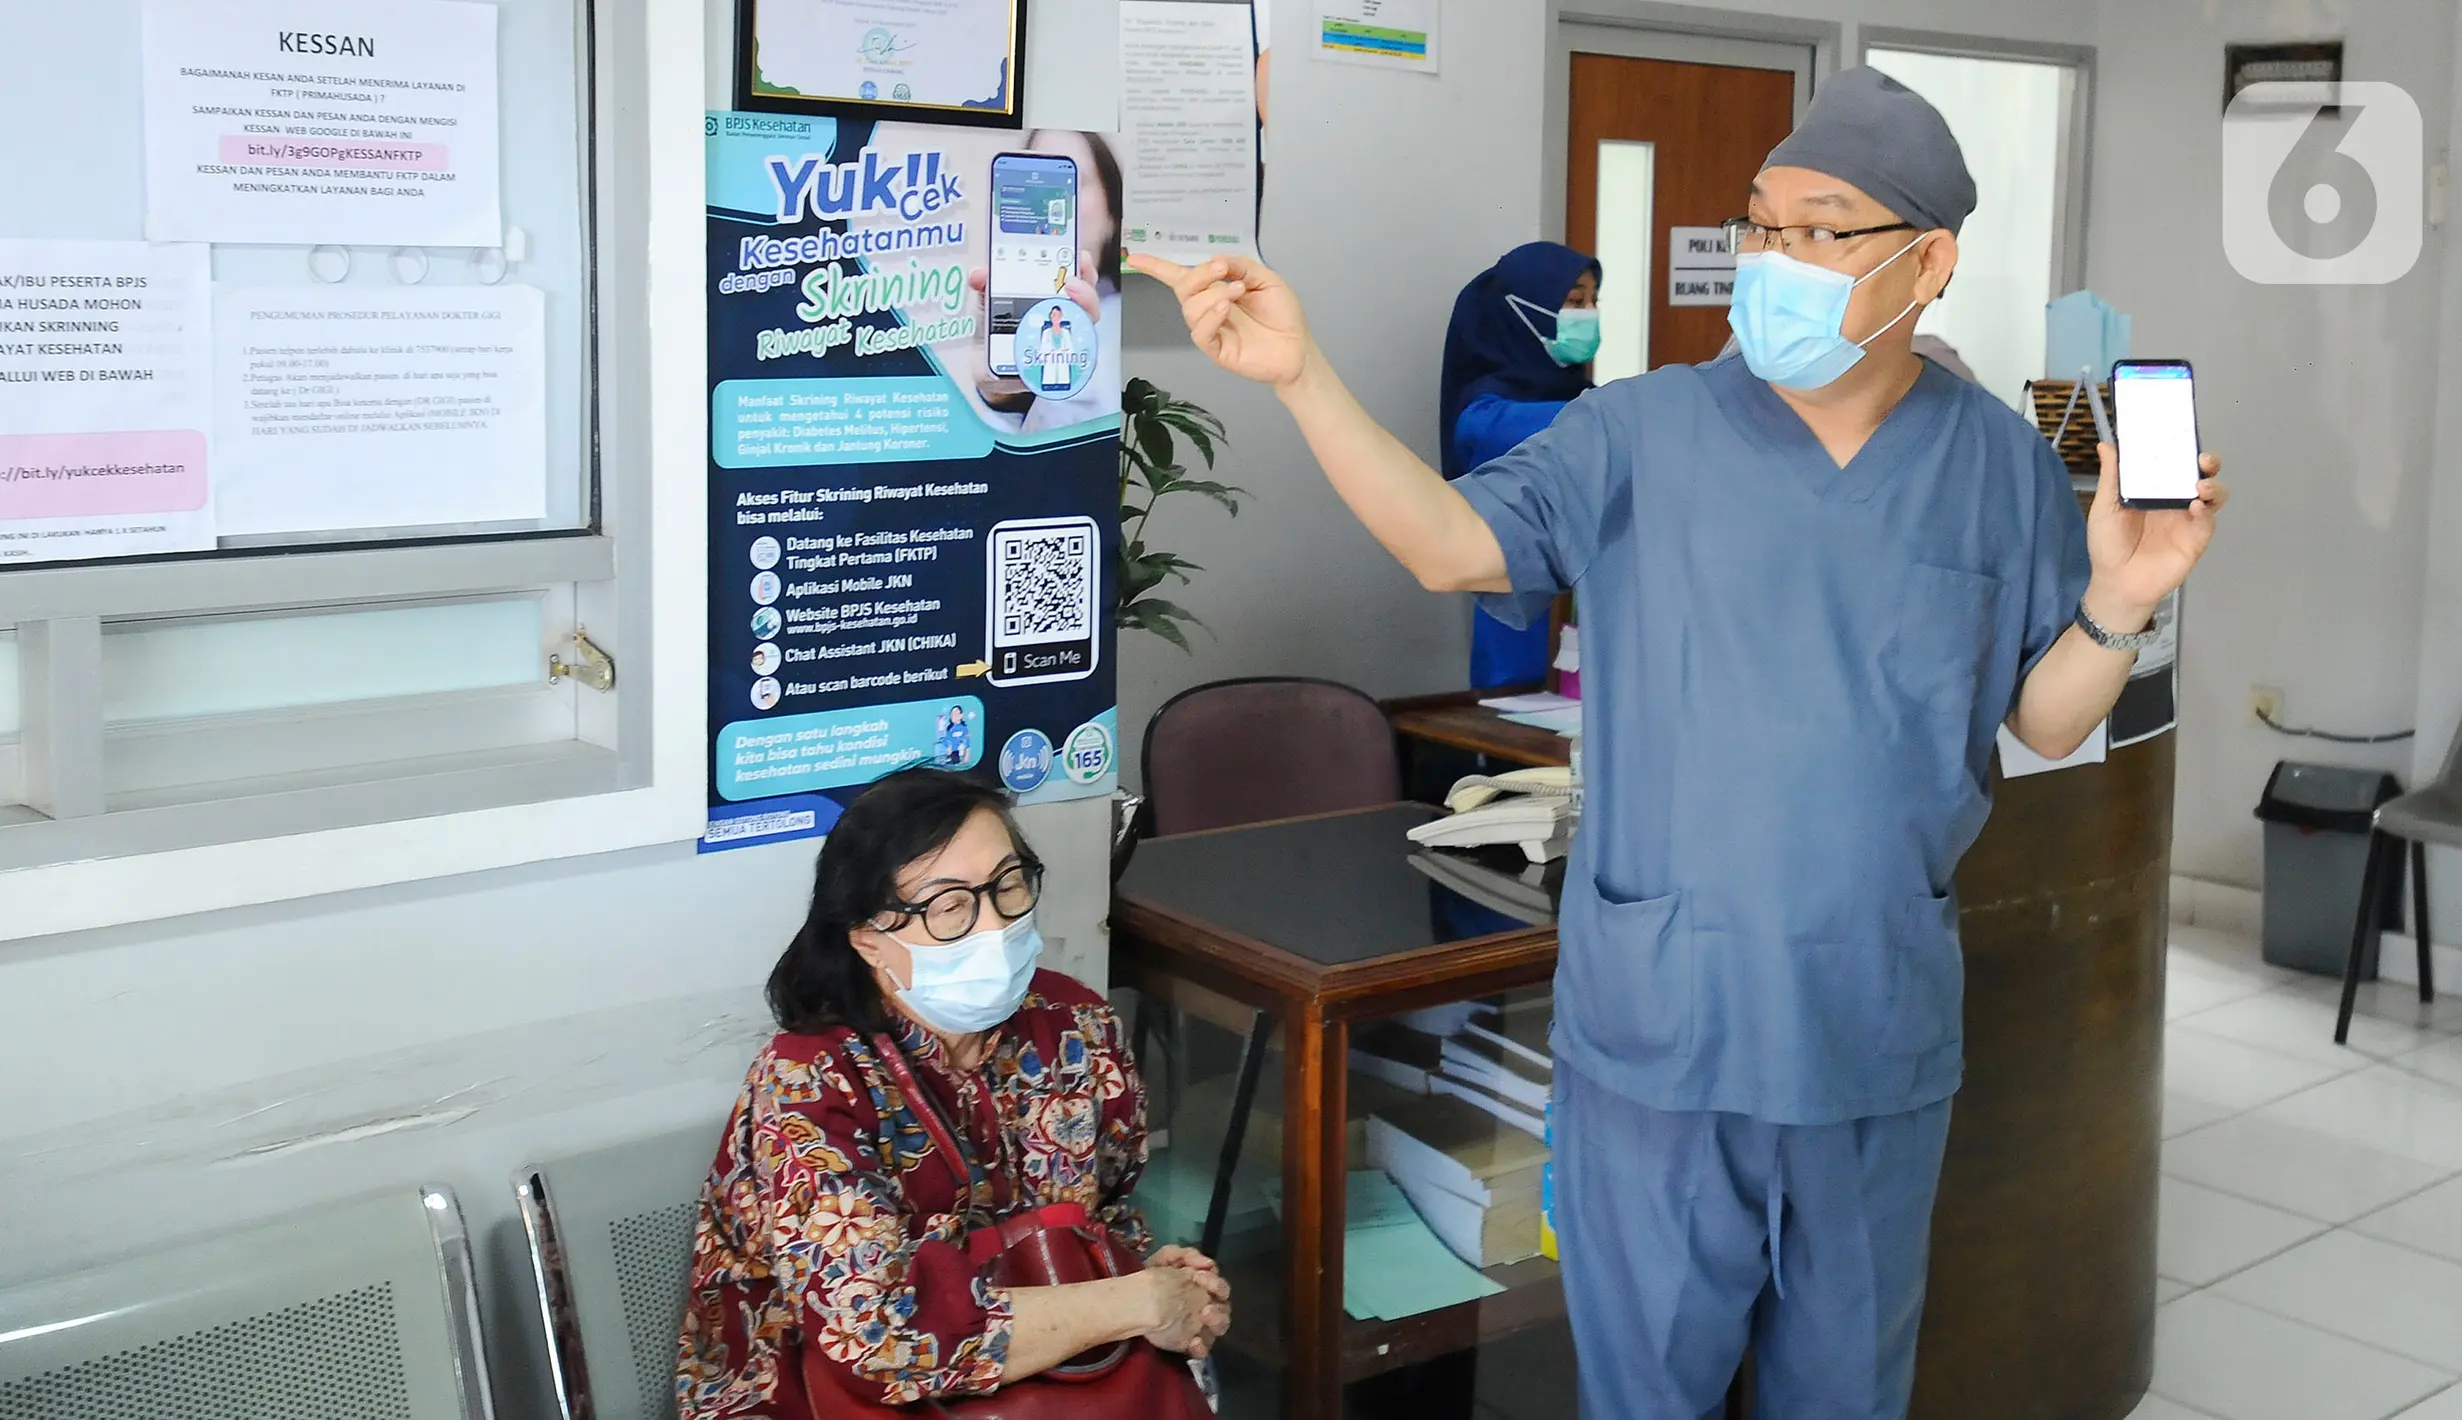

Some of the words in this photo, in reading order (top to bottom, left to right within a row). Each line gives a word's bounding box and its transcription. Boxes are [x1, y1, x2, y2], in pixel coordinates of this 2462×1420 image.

[280, 31, 374, 57] KESSAN
[180, 67, 251, 80] BAGAIMANAH
[253, 72, 284, 82] KESAN
[287, 74, 314, 84] ANDA
[317, 75, 356, 86] SETELAH
[359, 77, 410, 88] MENERIMA
[412, 80, 454, 92] LAYANAN
[456, 84, 466, 92] DI
[271, 88, 294, 98] FKTP
[302, 90, 372, 102] PRIMAHUSADA
[192, 105, 251, 117] SAMPAIKAN
[254, 108, 291, 118] KESSAN
[293, 110, 314, 120] DAN
[317, 112, 346, 121] PESAN
[349, 112, 376, 122] ANDA
[378, 114, 416, 124] DENGAN
[419, 116, 458, 126] MENGISI
[725, 117, 750, 130] BPJS
[752, 119, 811, 132] Kesehatan
[244, 124, 280, 134] KESSAN
[285, 126, 307, 135] WEB
[309, 127, 348, 136] GOOGLE
[350, 128, 360, 137] DI
[362, 130, 398, 139] BAWAH
[400, 131, 412, 140] INI
[196, 164, 237, 175] KESSAN
[240, 166, 263, 176] DAN
[266, 166, 298, 177] PESAN
[300, 168, 331, 178] ANDA
[334, 169, 394, 180] MEMBANTU
[396, 172, 419, 181] FKTP
[421, 172, 456, 182] DALAM
[233, 182, 318, 194] MENINGKATKAN
[320, 186, 368, 196] LAYANAN
[370, 187, 394, 196] BAGI
[396, 188, 425, 198] ANDA
[743, 222, 964, 268] Kesehatanmu
[1688, 240, 1713, 252] POLI
[51, 276, 112, 288] PESERTA
[116, 276, 148, 288] BPJS
[720, 270, 794, 293] dengan
[800, 260, 963, 318] Skrining
[1675, 282, 1710, 296] RUANG
[0, 298, 13, 310] A
[18, 298, 80, 310] HUSADA
[84, 298, 142, 310] MOHON
[250, 310, 325, 321] PENGUMUMAN
[327, 310, 379, 320] PROSEDUR
[380, 310, 439, 320] PELAYANAN
[441, 310, 478, 320] DOKTER
[0, 321, 34, 332] KAN
[39, 321, 120, 332] SKRINNING
[758, 320, 851, 360] Riwayat
[856, 316, 975, 355] Kesehatan
[38, 343, 122, 354] KESEHATAN
[1024, 348, 1088, 368] Skrining
[42, 370, 76, 382] WEB
[80, 370, 95, 382] DI
[100, 370, 154, 381] BAWAH
[738, 395, 784, 408] Manfaat
[789, 394, 838, 408] Skrining
[844, 392, 886, 406] Riwayat
[892, 392, 950, 404] Kesehatan
[738, 411, 772, 424] untuk
[779, 408, 848, 424] mengetahui
[854, 408, 863, 420] 4
[868, 408, 911, 421] potensi
[916, 407, 950, 418] risiko
[793, 425, 842, 438] Diabetes
[738, 442, 771, 457] Ginjal
[774, 442, 812, 454] Kronik
[814, 440, 836, 452] dan
[837, 439, 882, 453] Jantung
[736, 492, 779, 506] Akses
[780, 490, 814, 504] Fitur
[816, 486, 872, 504] Skrining
[874, 484, 924, 501] Riwayat
[925, 482, 989, 498] Kesehatan
[736, 510, 766, 525] bisa
[768, 507, 824, 524] melalui:
[786, 536, 834, 552] Datang
[836, 534, 853, 548] ke
[854, 531, 908, 547] Fasilitas
[908, 528, 974, 544] Kesehatan
[786, 554, 837, 572] Tingkat
[838, 550, 894, 566] Pertama
[894, 546, 938, 564] (FKTP)
[786, 580, 840, 598] Aplikasi
[840, 577, 884, 593] Mobile
[884, 574, 913, 590] JKN
[786, 606, 838, 623] Website
[840, 602, 873, 618] BPJS
[874, 599, 941, 616] Kesehatan
[786, 614, 918, 635] www.bpjs-kesehatan.go.id
[784, 648, 816, 663] Chat
[817, 643, 876, 660] Assistant
[878, 638, 906, 654] JKN
[907, 632, 957, 652] (CHIKA)
[1023, 652, 1057, 670] Scan
[1059, 650, 1082, 665] Me
[784, 682, 817, 697] Atau
[818, 678, 848, 693] scan
[850, 672, 900, 689] barcode
[902, 666, 949, 684] berikut
[734, 731, 792, 750] Dengan
[794, 726, 828, 743] satu
[830, 719, 890, 739] langkah
[734, 751, 764, 766] kita
[766, 747, 798, 763] bisa
[800, 743, 836, 758] tahu
[836, 734, 890, 753] kondisi
[1074, 750, 1103, 769] 165
[735, 763, 811, 784] kesehatan
[814, 755, 857, 773] sedini
[858, 746, 922, 767] mungkin
[707, 824, 746, 840] SEMUA
[749, 815, 812, 834] TERTOLONG
